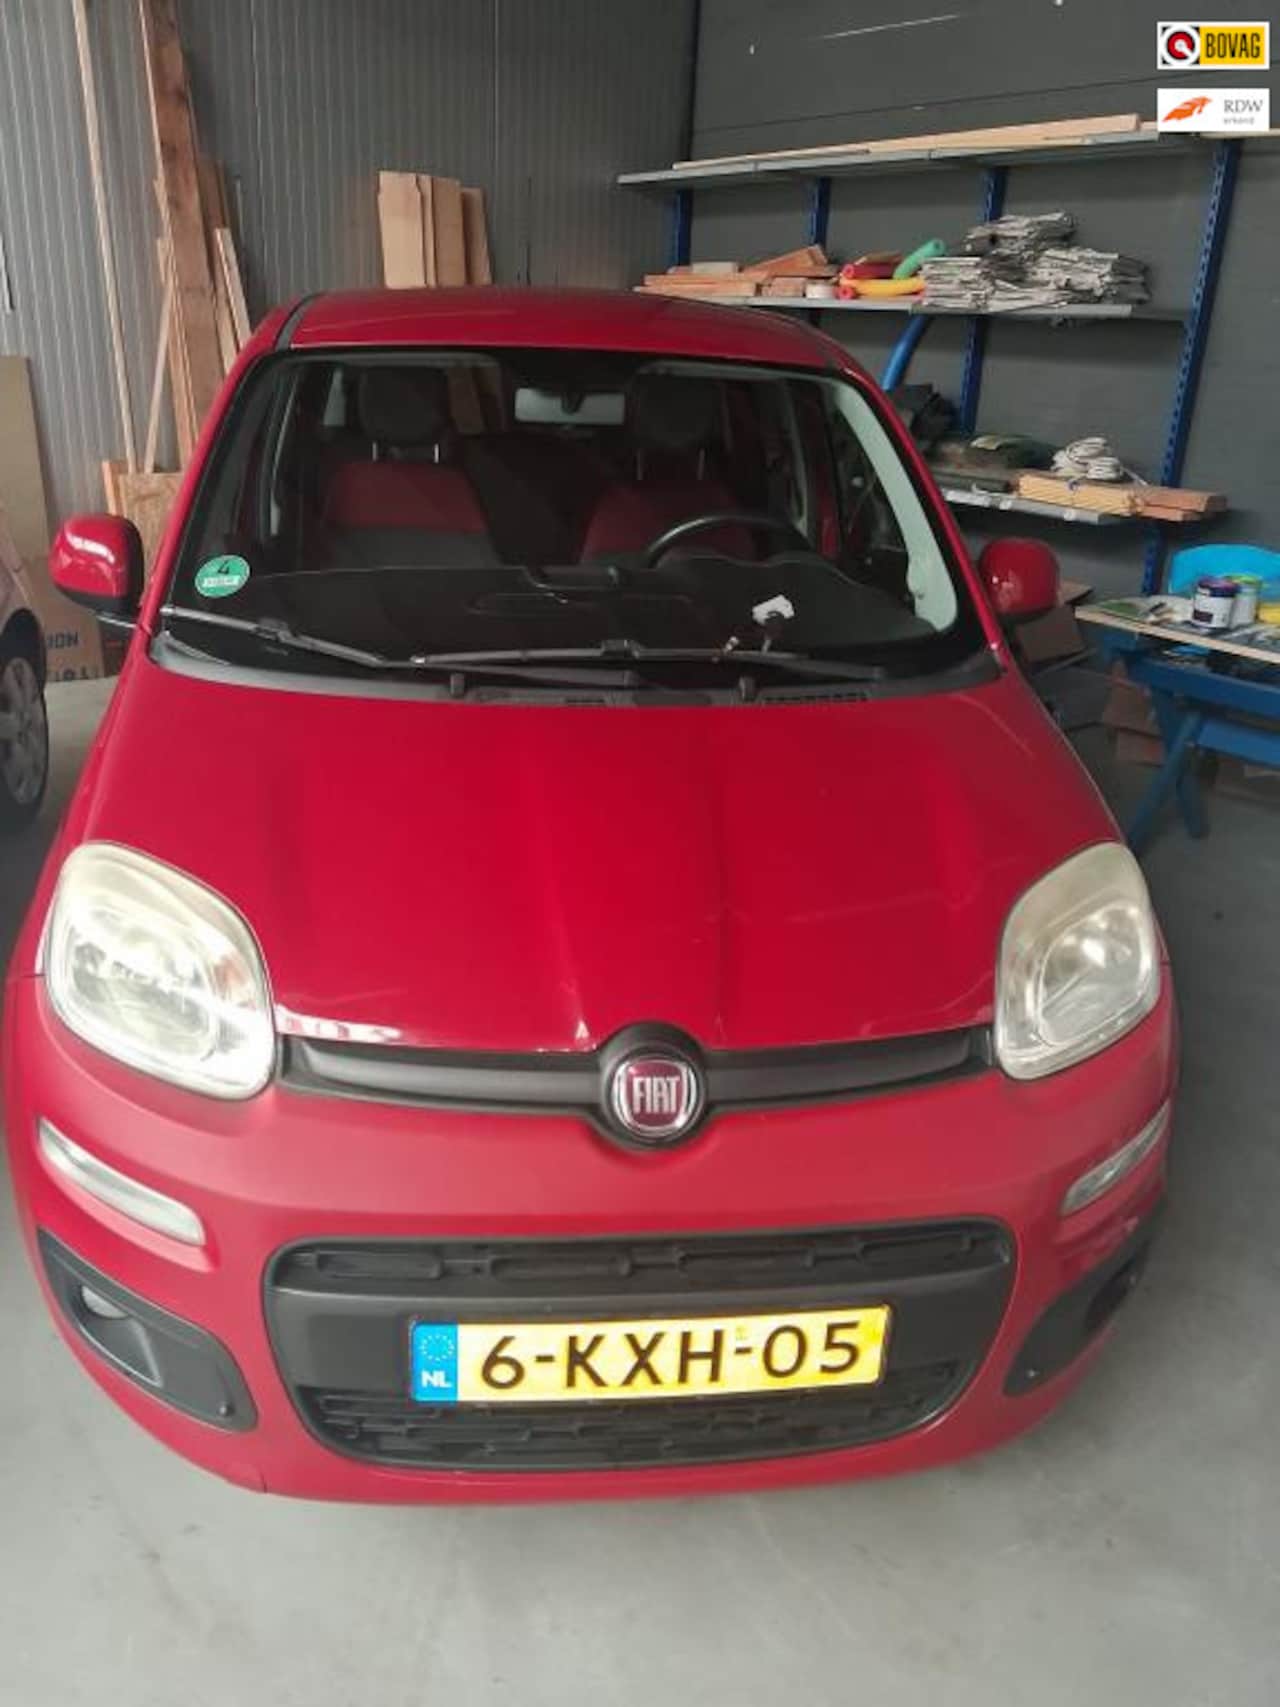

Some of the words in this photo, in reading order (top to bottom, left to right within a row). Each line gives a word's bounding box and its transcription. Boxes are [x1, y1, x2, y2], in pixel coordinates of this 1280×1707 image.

[633, 1076, 681, 1114] FIAT
[481, 1321, 860, 1390] 6-KXH-05
[421, 1370, 453, 1388] NL
